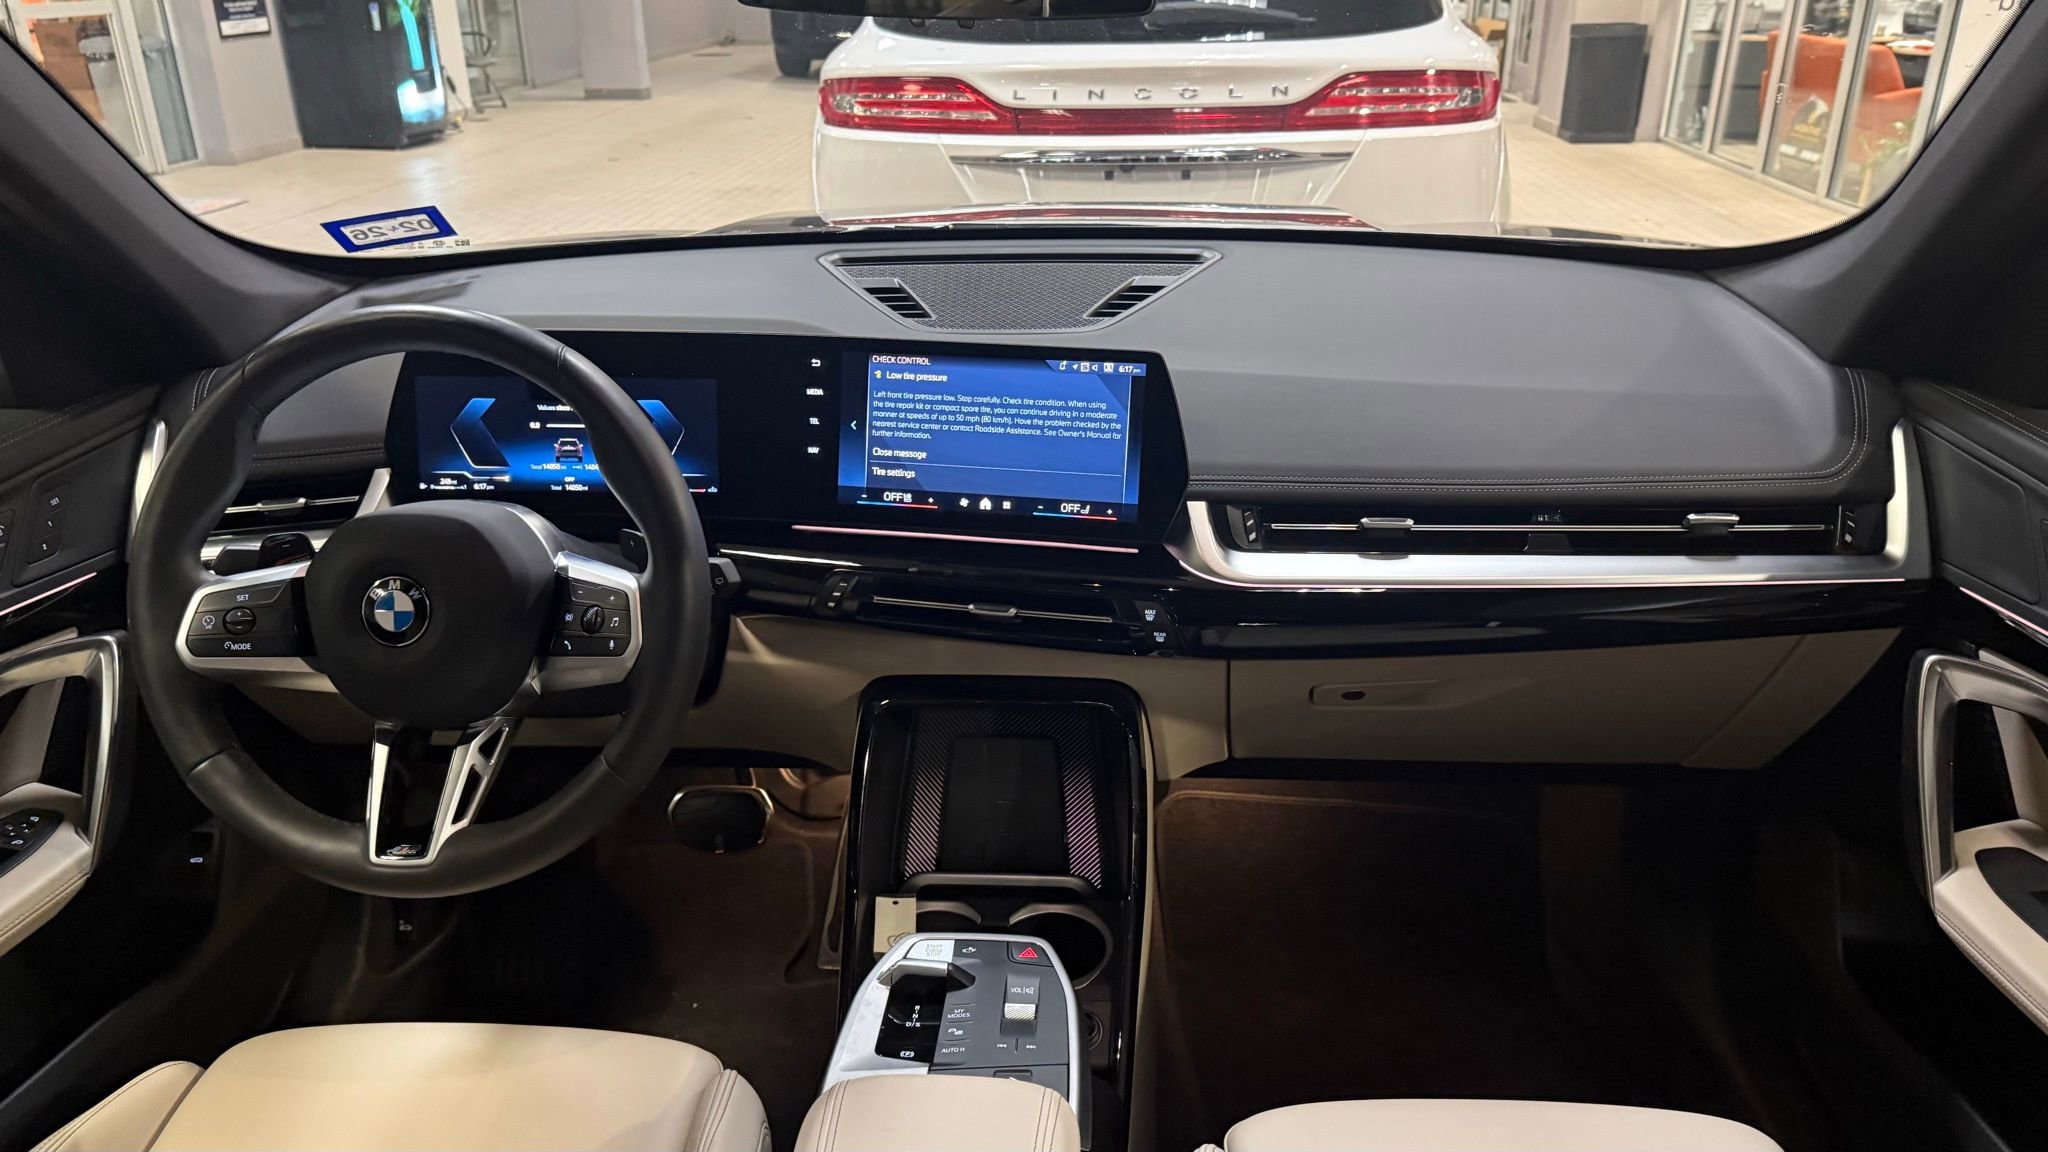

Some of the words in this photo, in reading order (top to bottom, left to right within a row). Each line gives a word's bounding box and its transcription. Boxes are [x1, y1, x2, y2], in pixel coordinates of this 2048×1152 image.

[1013, 86, 1288, 100] LINCOLN
[872, 355, 896, 363] CHECK
[897, 357, 931, 365] CONTROL
[887, 371, 902, 379] Low
[903, 372, 915, 380] tire
[916, 374, 947, 382] pressure
[887, 391, 902, 399] front
[914, 393, 942, 401] pressure
[957, 394, 972, 403] Stop
[1002, 397, 1022, 405] Check
[1035, 399, 1066, 407] condition.
[1067, 400, 1087, 408] When
[1088, 402, 1106, 410] using
[873, 400, 884, 408] the
[896, 402, 915, 410] repair
[932, 404, 960, 412] compact
[980, 406, 993, 414] tire,
[1019, 408, 1047, 416] continue
[1048, 409, 1071, 418] driving
[1085, 411, 1118, 420] moderate
[906, 412, 930, 420] speeds
[938, 414, 947, 422] up
[956, 414, 964, 422] 50
[965, 415, 980, 423] mph
[1014, 417, 1031, 425] Have
[1044, 419, 1071, 427] problem
[1073, 421, 1100, 429] checked
[1101, 422, 1109, 430] by
[1110, 422, 1122, 430] the
[872, 429, 894, 437] further
[894, 430, 932, 439] information.
[897, 421, 920, 429] service
[950, 424, 974, 432] contact
[974, 425, 1005, 434] Roadside
[1005, 426, 1043, 436] Assistance.
[1043, 428, 1057, 436] See
[1058, 429, 1086, 438] Owner's
[1086, 431, 1112, 439] Manual
[1112, 432, 1122, 440] for
[872, 447, 893, 456] Close
[893, 450, 928, 460] message
[871, 466, 886, 476] Tire
[886, 469, 916, 479] settings
[50, 497, 60, 506] SET
[883, 491, 902, 502] OFF
[1060, 503, 1080, 513] OFF
[369, 579, 422, 600] BMW
[236, 594, 249, 602] SET
[230, 642, 252, 650] MODE
